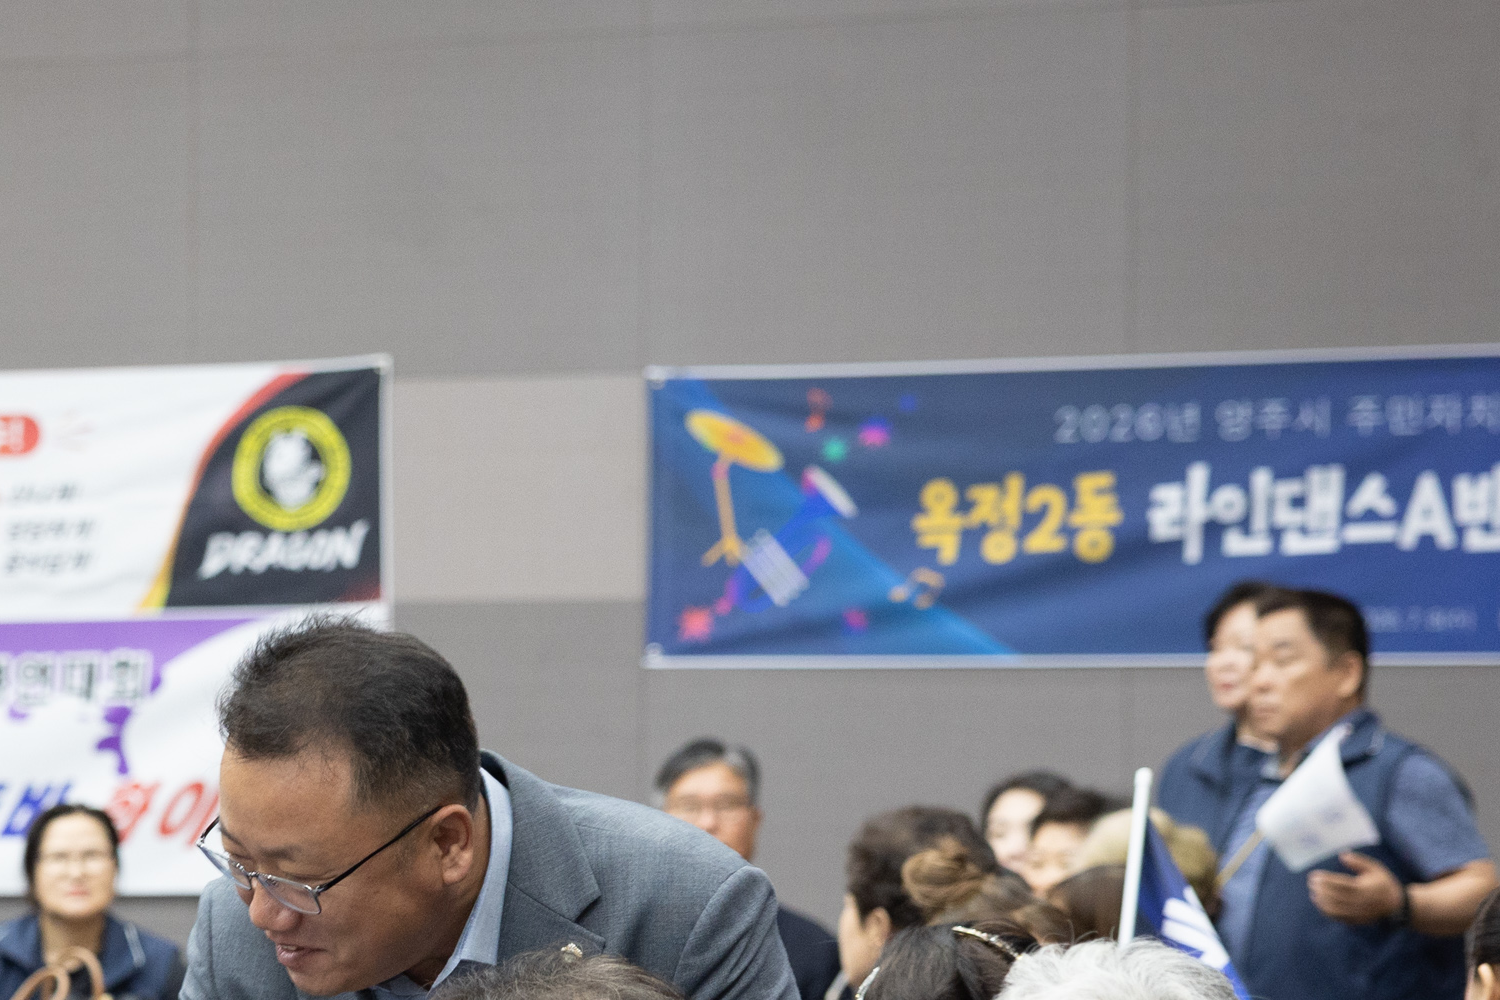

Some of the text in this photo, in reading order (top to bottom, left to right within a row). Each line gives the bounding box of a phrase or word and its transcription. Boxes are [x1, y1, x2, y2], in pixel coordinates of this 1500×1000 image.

[1052, 401, 1202, 444] 2026년
[198, 517, 372, 580] DRAGON
[911, 468, 1125, 566] 옥정2동
